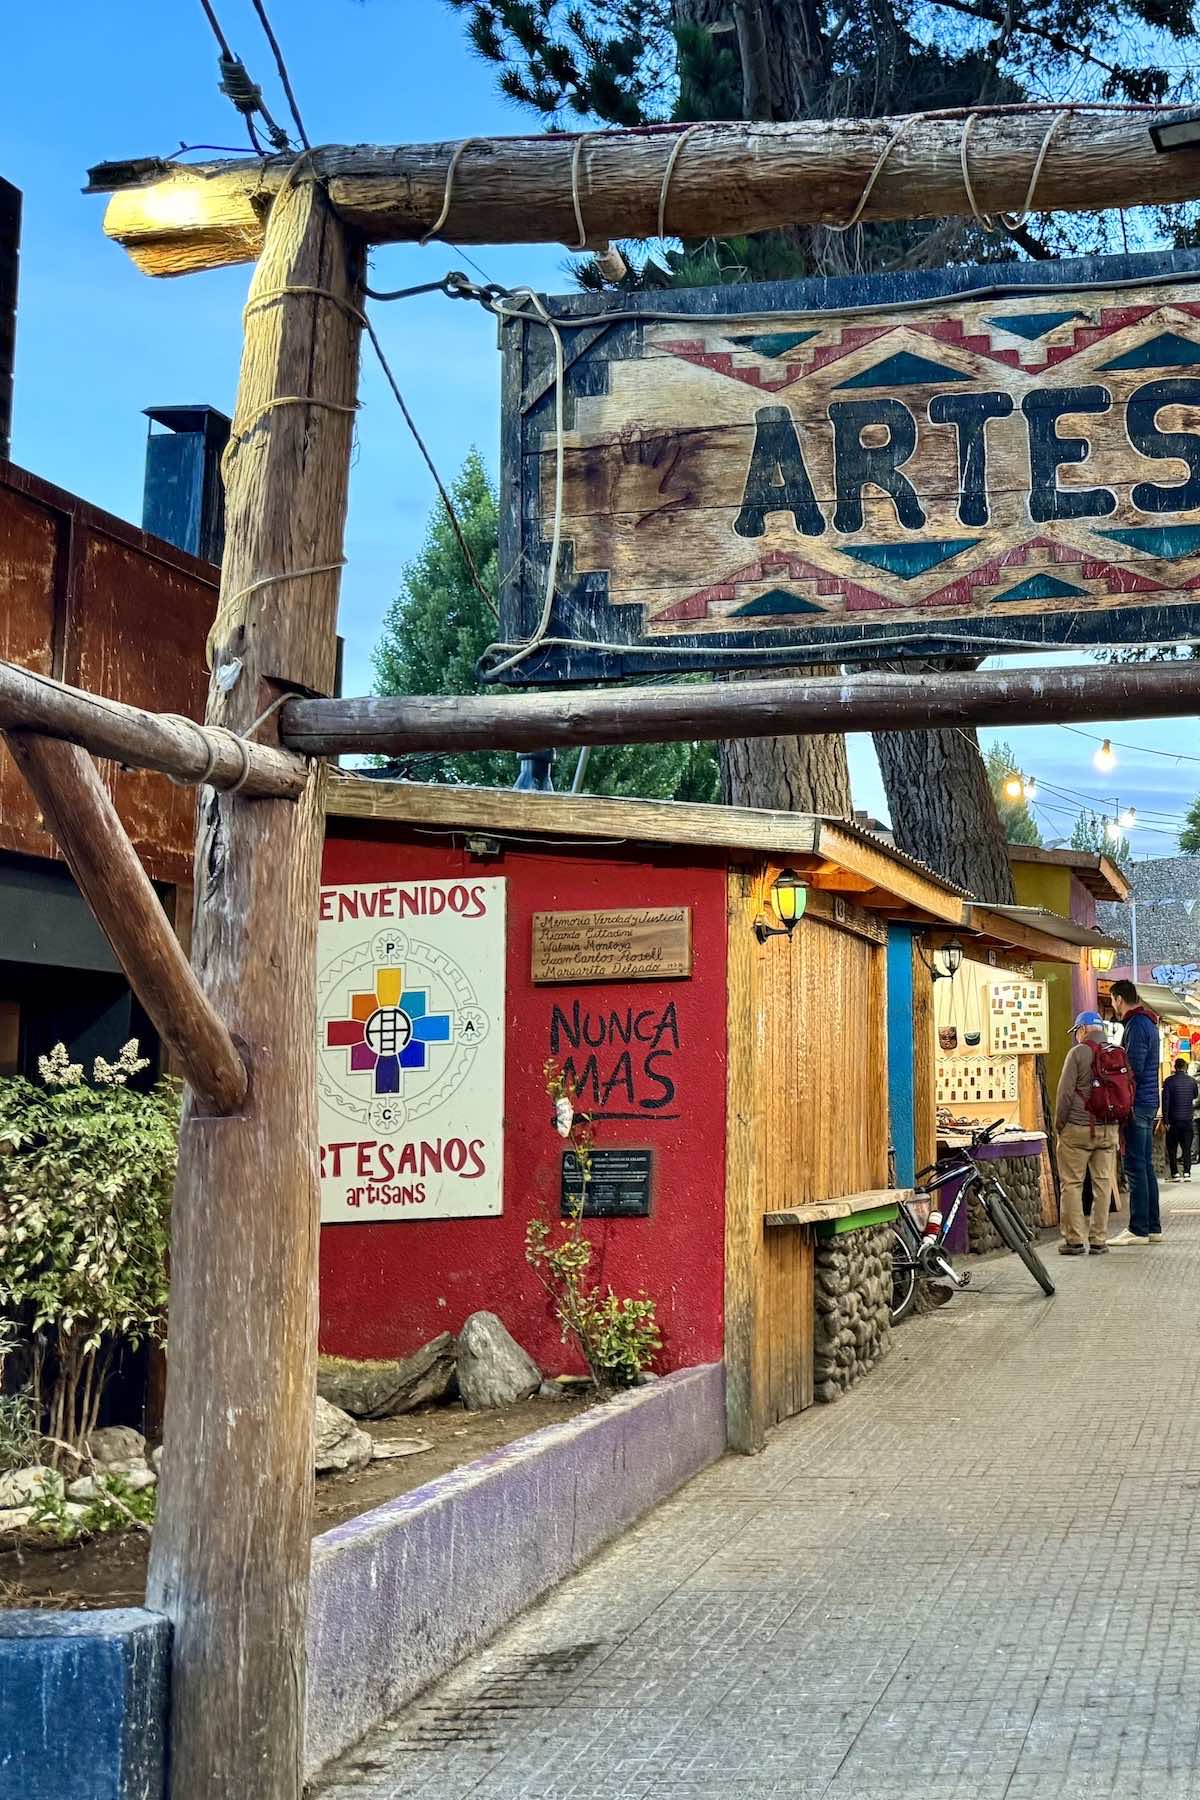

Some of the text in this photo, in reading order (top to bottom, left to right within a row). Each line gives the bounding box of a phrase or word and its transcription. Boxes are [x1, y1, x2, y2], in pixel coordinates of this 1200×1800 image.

[540, 916, 590, 929] Memoria
[386, 943, 395, 954] P
[542, 965, 606, 979] Margarita
[611, 963, 661, 977] Delgado
[465, 1020, 475, 1032] A
[550, 999, 680, 1055] NUNCA
[559, 1050, 676, 1109] MAS
[382, 1110, 392, 1120] C
